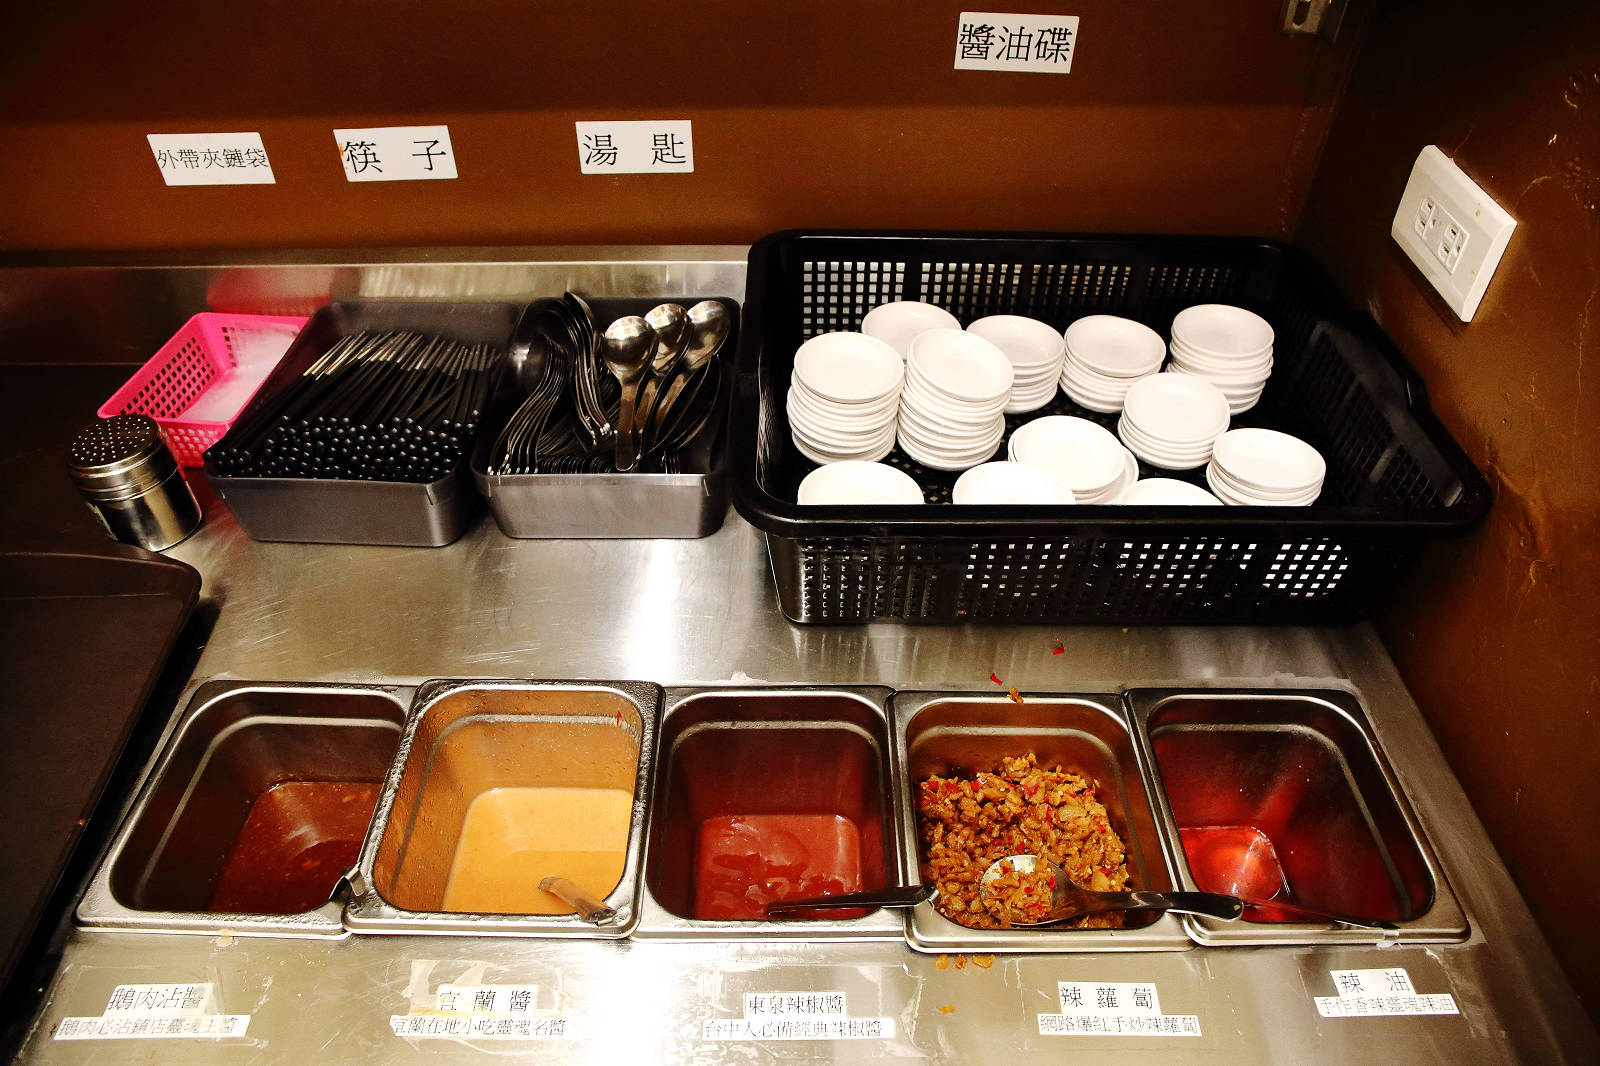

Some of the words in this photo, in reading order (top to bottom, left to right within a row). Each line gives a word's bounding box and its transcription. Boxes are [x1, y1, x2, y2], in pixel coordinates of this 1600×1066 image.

[959, 23, 1073, 64] 醬油碟
[157, 147, 269, 170] 外帶夾鏈袋
[343, 139, 447, 174] 筷子
[582, 132, 687, 166] 湯匙
[440, 990, 531, 1012] 宜蘭醬
[748, 994, 845, 1015] 東泉辣椒醬
[705, 1019, 882, 1039] 台中人必備經典辣椒醬
